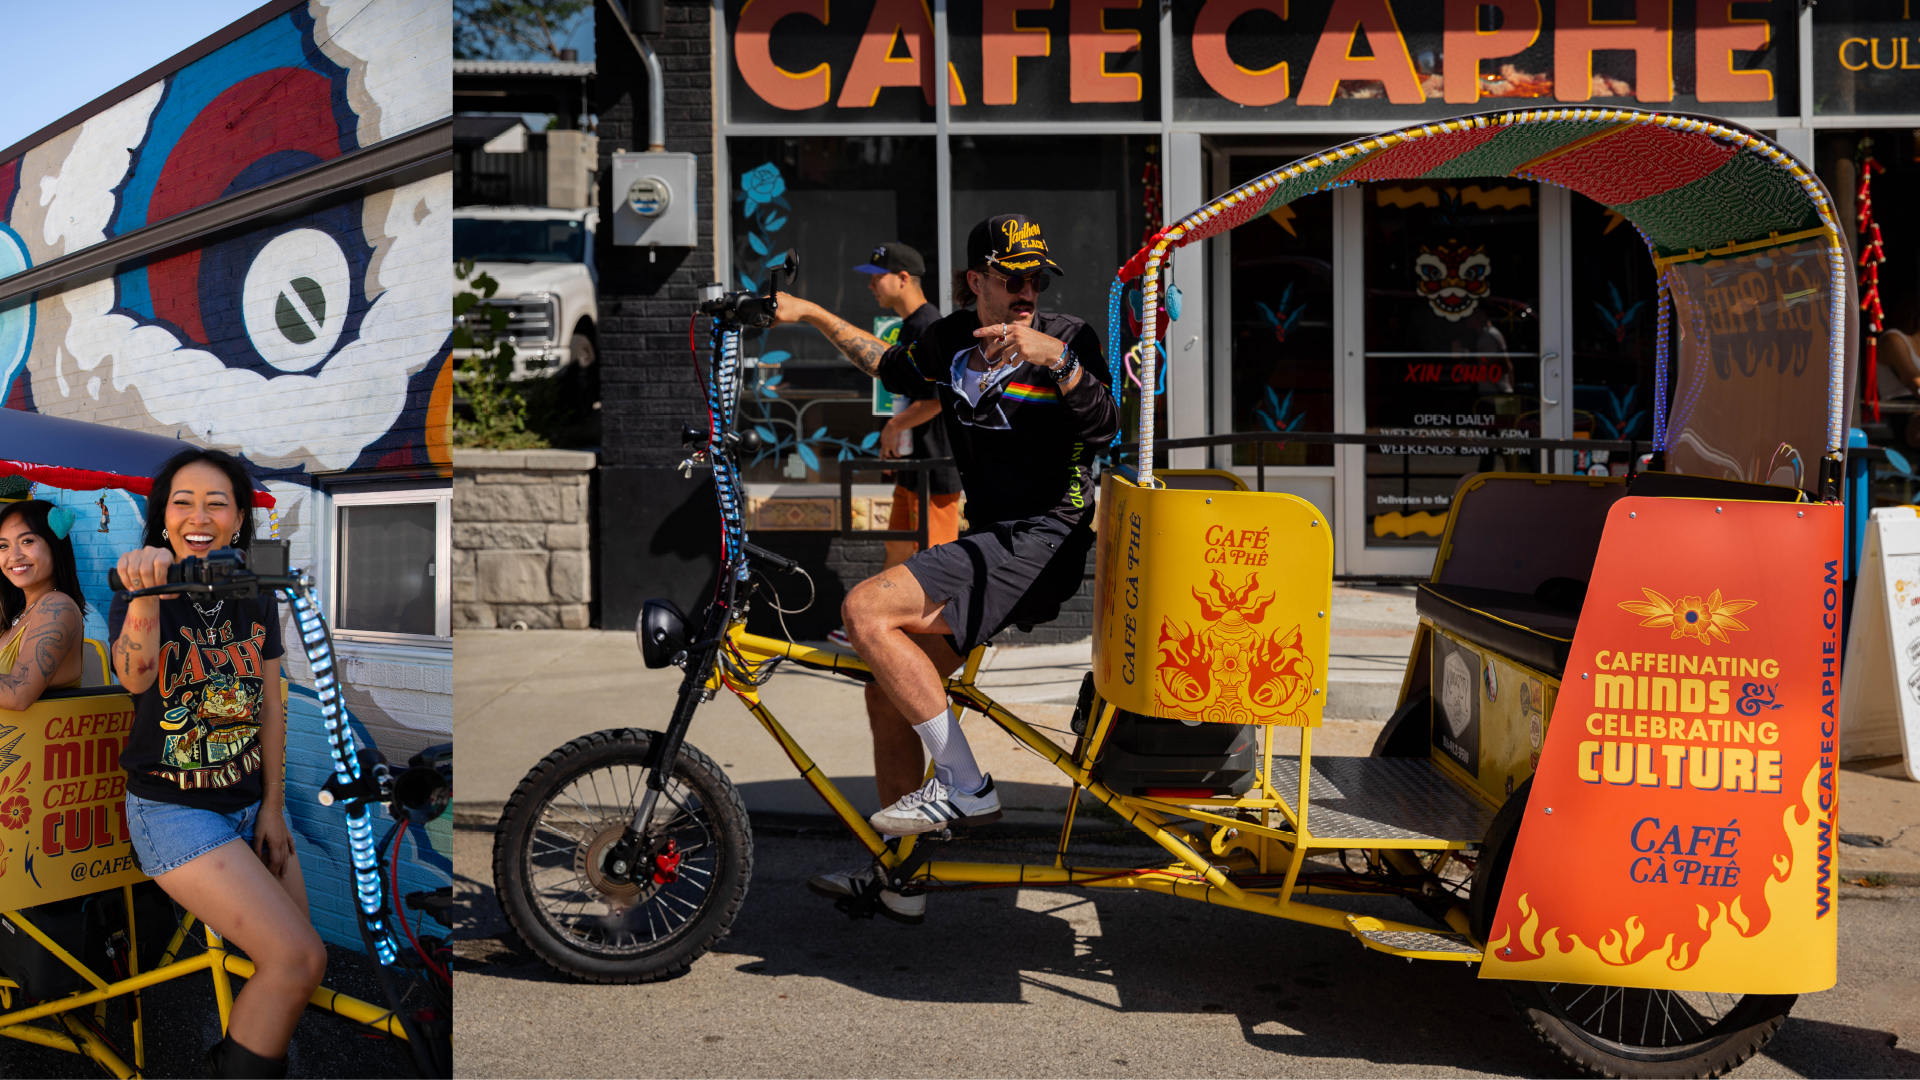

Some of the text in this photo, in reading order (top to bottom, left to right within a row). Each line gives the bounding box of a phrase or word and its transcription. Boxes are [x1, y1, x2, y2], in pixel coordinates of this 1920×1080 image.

[1838, 37, 1920, 71] CUL
[1404, 357, 1502, 383] XIN CHÀO
[1413, 414, 1495, 425] OPEN DAILY!
[1377, 494, 1450, 504] Deliveries to the
[1205, 524, 1270, 550] CAFÉ
[1122, 613, 1137, 686] CAFÉ
[1595, 650, 1780, 679] CAFFEINATING
[1594, 673, 1785, 717] MINDS &
[1585, 712, 1780, 745] CELEBRATING
[1816, 559, 1839, 920] WWW.CAFECAPHE.COM
[43, 735, 129, 781] MIN
[1578, 740, 1783, 794] CULTURE
[42, 775, 126, 809] CELEB
[1630, 816, 1741, 858] CAFÉ
